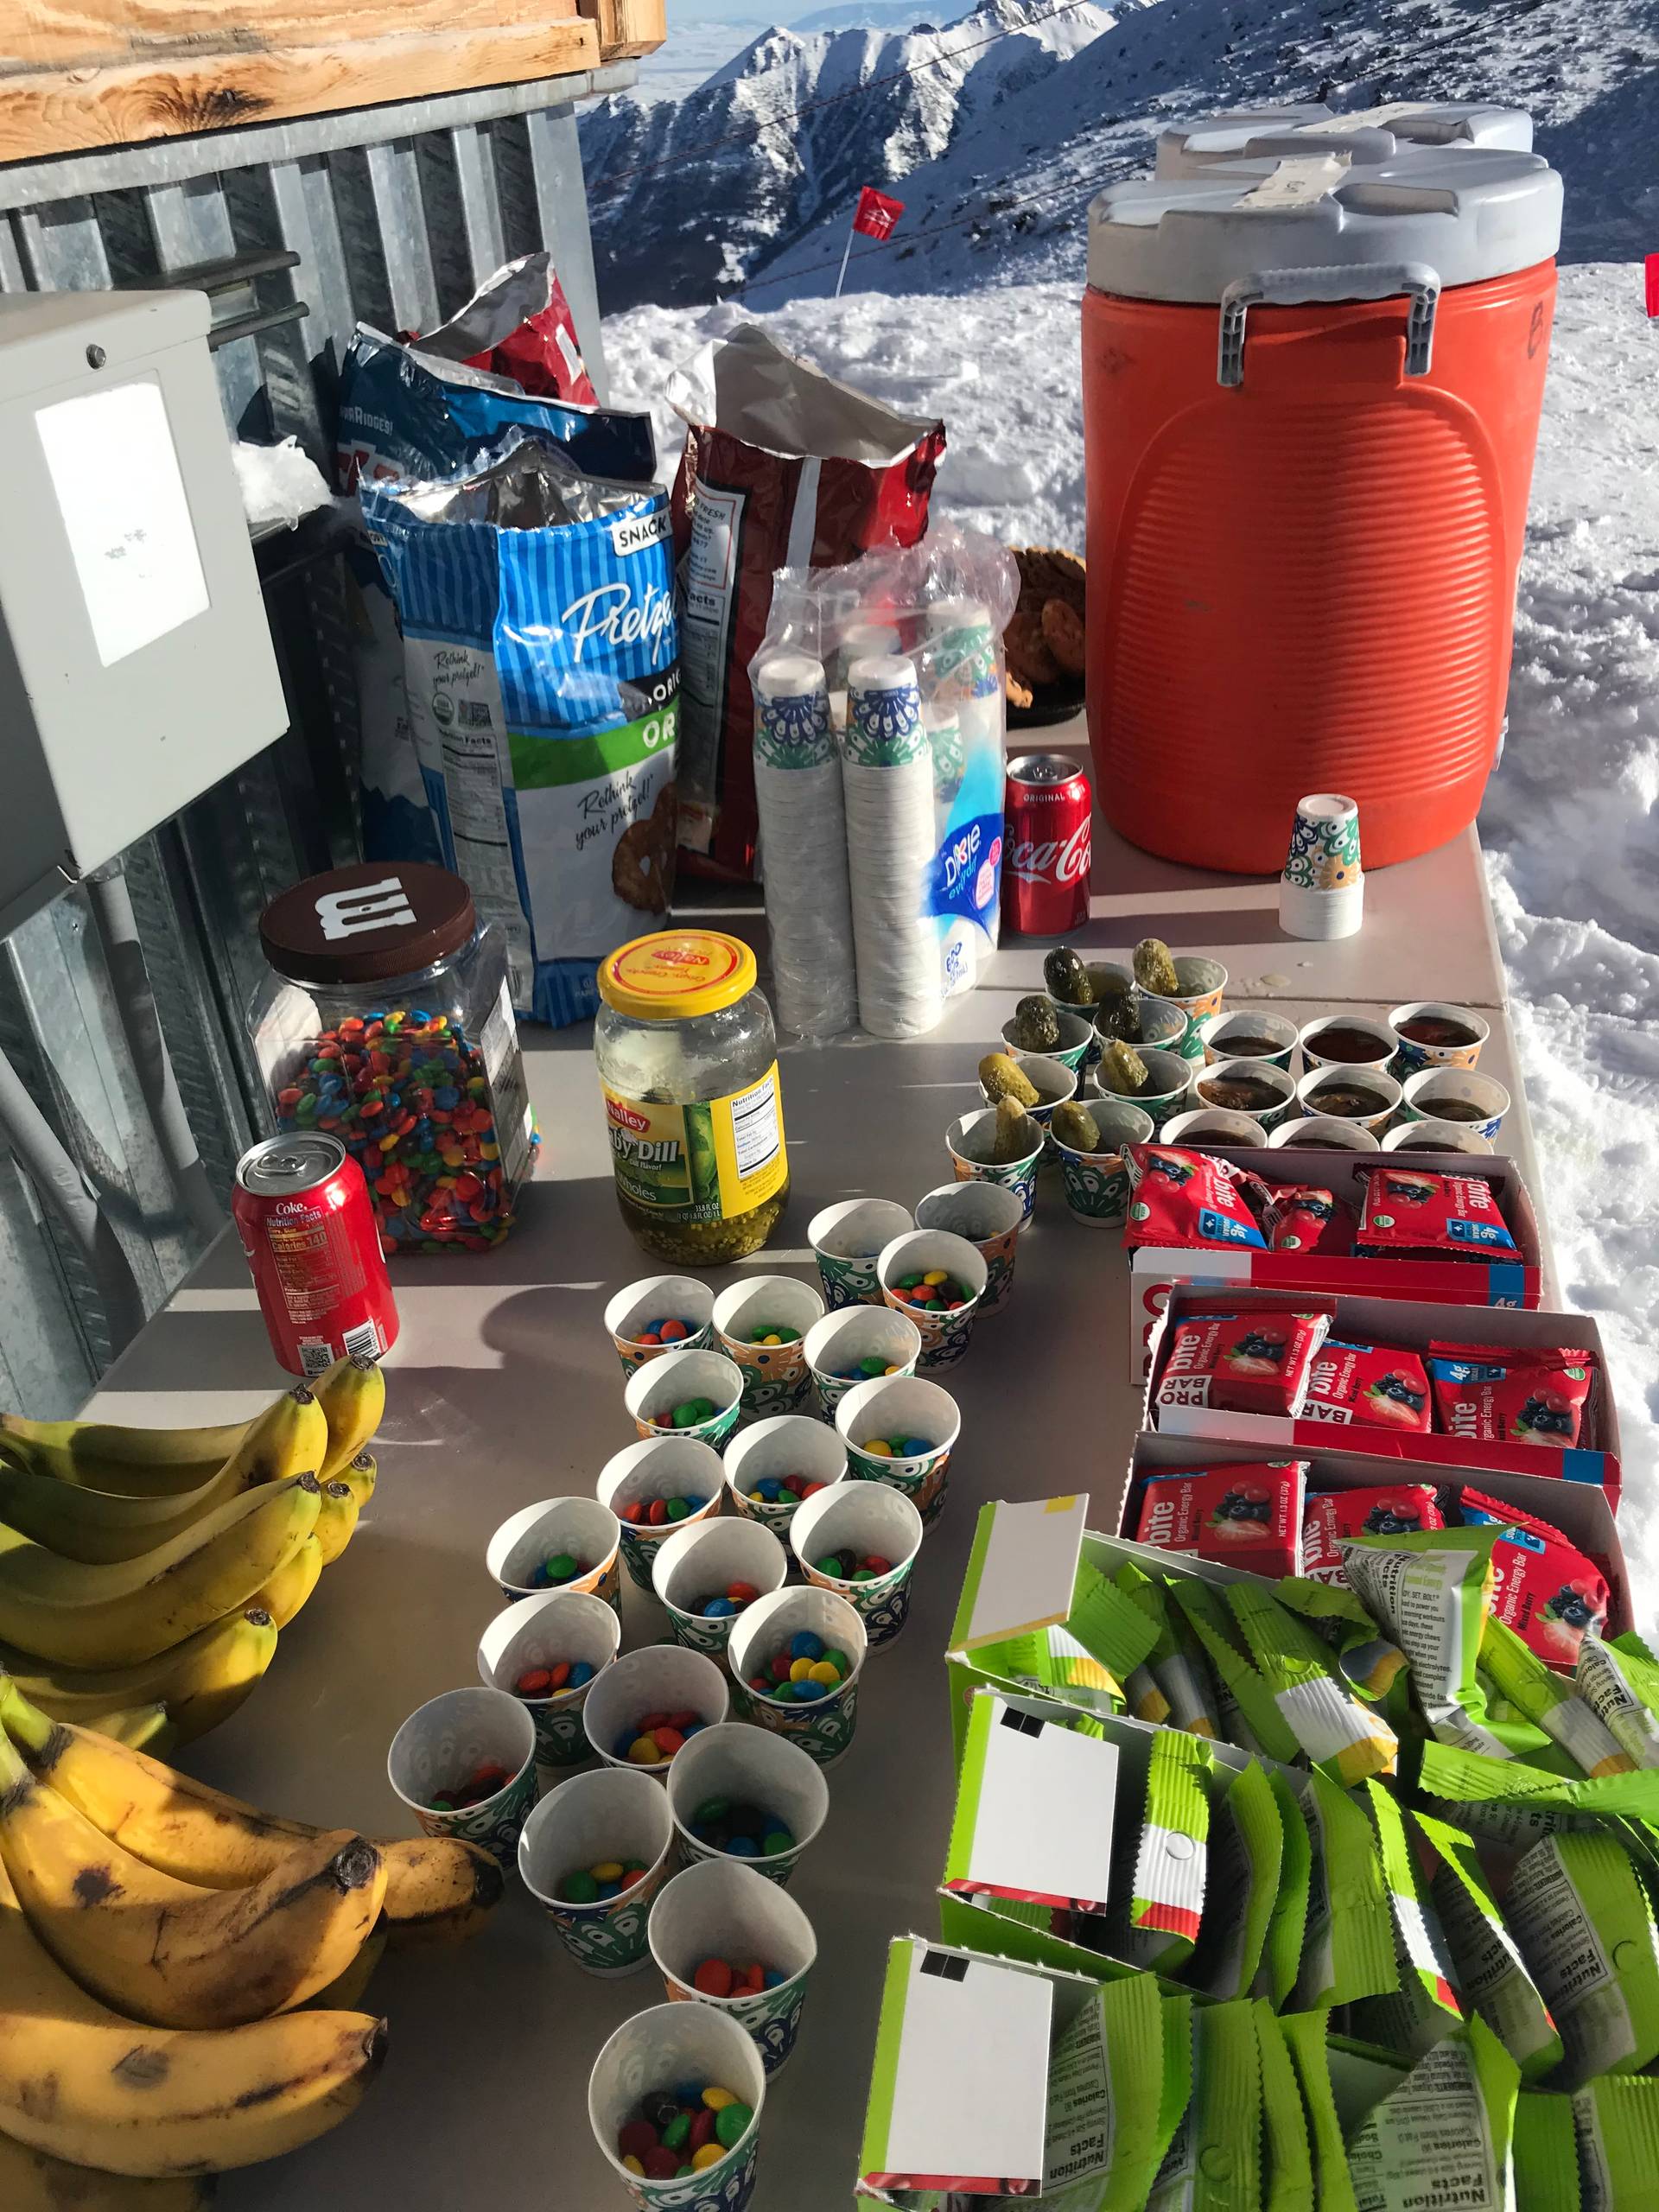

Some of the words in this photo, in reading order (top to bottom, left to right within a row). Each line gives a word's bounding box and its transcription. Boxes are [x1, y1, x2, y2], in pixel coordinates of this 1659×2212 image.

[619, 515, 667, 548] SNACK
[690, 593, 716, 605] acts
[434, 650, 470, 670] Rethink
[577, 771, 637, 820] Rethink
[1023, 791, 1066, 802] ORIGINAL
[575, 819, 608, 852] your
[654, 950, 708, 965] Nalley
[732, 1090, 762, 1108] Nutrition
[607, 1101, 646, 1132] Nalley
[637, 1140, 678, 1163] Dill
[1213, 1176, 1236, 1208] bite
[266, 1215, 297, 1227] Nutrition
[300, 1211, 322, 1224] Facts
[272, 1241, 307, 1251] Calories
[307, 1230, 327, 1246] 140
[1230, 1223, 1249, 1239] 4g
[1471, 1224, 1480, 1239] SUGAR
[1479, 1227, 1499, 1241] 4g
[1166, 1334, 1202, 1372] bite
[1194, 1348, 1209, 1370] Organic
[1202, 1332, 1217, 1350] Energy
[1164, 1377, 1205, 1389] BAR
[1285, 1366, 1297, 1378] NET
[1310, 1361, 1338, 1395] bite
[1332, 1379, 1348, 1400] Organic
[1342, 1361, 1355, 1380] Energy
[1349, 1352, 1358, 1363] Bar
[1450, 1363, 1471, 1382] 4g
[1160, 1391, 1205, 1406] PRO
[1480, 1385, 1492, 1396] Bar
[1303, 1402, 1348, 1425] BAR
[1480, 1396, 1494, 1419] Energy
[1482, 1419, 1495, 1441] rganic
[1180, 1482, 1193, 1493] Bar
[1178, 1493, 1193, 1519] Energy
[1322, 1497, 1333, 1510] Bar
[1144, 1500, 1175, 1545] bite
[1174, 1519, 1190, 1543] Organic
[1278, 1515, 1287, 1526] WT
[1325, 1510, 1338, 1532] Energy
[1278, 1526, 1287, 1538] NET
[1326, 1531, 1340, 1558] Organic
[1512, 1552, 1528, 1567] Bar
[1389, 1554, 1411, 1614] Nutrition
[1507, 1567, 1527, 1593] Energy
[1499, 1593, 1518, 1625] Organic
[1522, 1592, 1536, 1613] Berry
[1516, 1613, 1531, 1631] Mixed
[1551, 1914, 1583, 1940] Calories
[1481, 1940, 1504, 1963] acts
[1466, 1952, 1512, 1989] utrition
[1560, 1948, 1598, 1979] Facts
[1072, 2089, 1107, 2108] Calories
[1070, 2133, 1105, 2157] Facts
[1432, 2139, 1482, 2151] Calories
[1049, 2151, 1105, 2180] Nutrition
[1431, 2173, 1484, 2190] Facts
[1402, 2188, 1485, 2209] Nutrition
